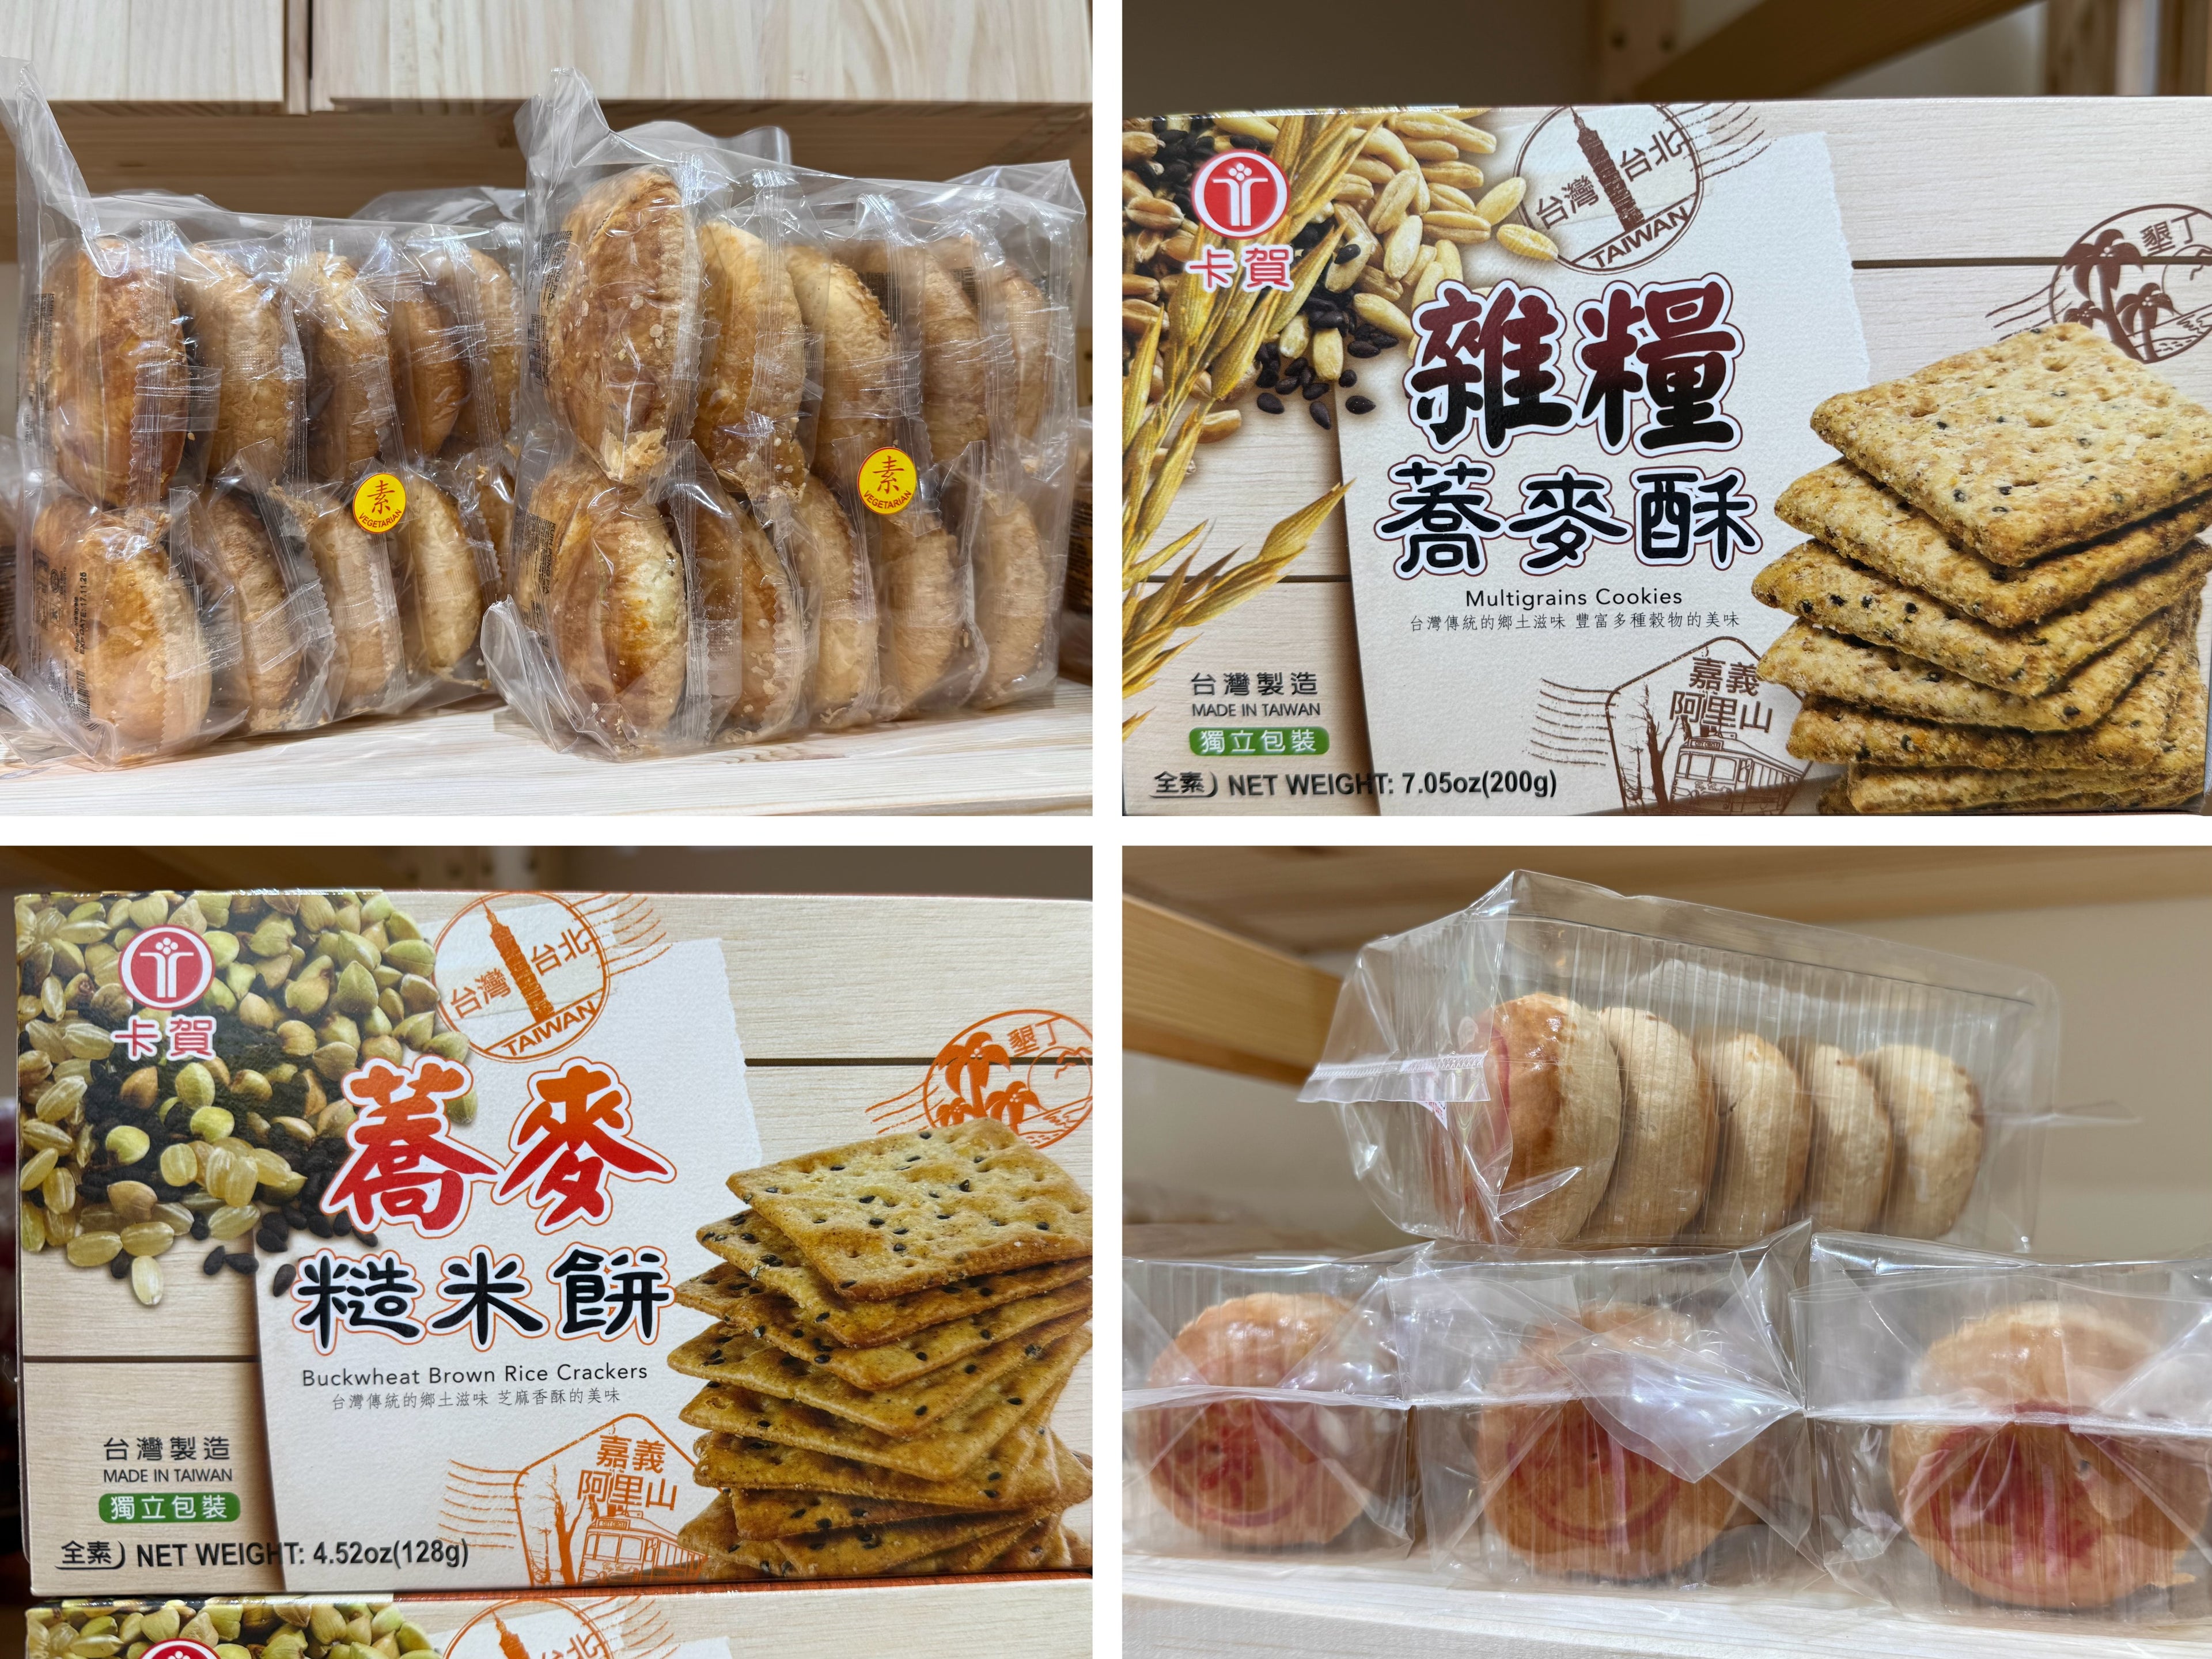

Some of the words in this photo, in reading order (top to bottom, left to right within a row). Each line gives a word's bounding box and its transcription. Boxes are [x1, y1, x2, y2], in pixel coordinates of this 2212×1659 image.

[1536, 175, 1599, 230] 台灣
[1619, 130, 1687, 182] 台北
[1589, 205, 1689, 268] TAIWAN
[1190, 248, 1290, 288] 卡賀
[1411, 282, 1737, 448] 雜糧
[872, 455, 905, 494] 素
[367, 480, 395, 514] 素
[863, 490, 912, 509] VEGETARIAN
[359, 509, 402, 528] VEGETARIAN
[1381, 461, 1755, 570] 蕎麥酥
[548, 522, 556, 546] KUIH
[1466, 589, 1588, 610] Multigrains
[1596, 587, 1683, 605] Cookies
[1410, 614, 1566, 631] 台灣傳統的鄉土滋味
[1575, 612, 1740, 629] 豐富多種穀物的美味
[1191, 672, 1318, 696] 台灣製造
[1689, 657, 1759, 696] 嘉義
[1192, 703, 1236, 716] MADE
[1241, 703, 1257, 716] IN
[1262, 703, 1321, 716] TAIWAN
[1669, 690, 1772, 733] 阿里山
[1200, 729, 1317, 753] 獨立包裝
[1228, 774, 1278, 796] NET
[1285, 772, 1394, 795] WEIGHT:
[1402, 769, 1556, 798] 7.05oz(200g)
[450, 968, 512, 1018] 台灣
[531, 928, 591, 976] 台北
[115, 1019, 213, 1056] 卡賀
[502, 1000, 597, 1056] TAIWAN
[329, 1060, 673, 1229] 蕎麥
[298, 1249, 669, 1349] 糙米餅
[302, 1368, 420, 1386] Buckwheat
[429, 1366, 495, 1384] Brown
[505, 1365, 548, 1382] Rice
[557, 1362, 648, 1381] Crackers
[332, 1391, 488, 1410] 台灣傳統的鄉土滋味
[498, 1388, 620, 1405] 芝麻香酥的美味
[104, 1436, 230, 1461] 台灣製造
[596, 1435, 665, 1474] 嘉義
[104, 1469, 148, 1482] MADE
[154, 1469, 169, 1482] IN
[174, 1468, 232, 1482] TAIWAN
[577, 1469, 677, 1510] 阿里山
[111, 1494, 227, 1520] 獨立包裝
[137, 1544, 188, 1567] NET
[195, 1541, 305, 1566] WEIGHT:
[313, 1538, 469, 1569] 4.52oz(128g)
